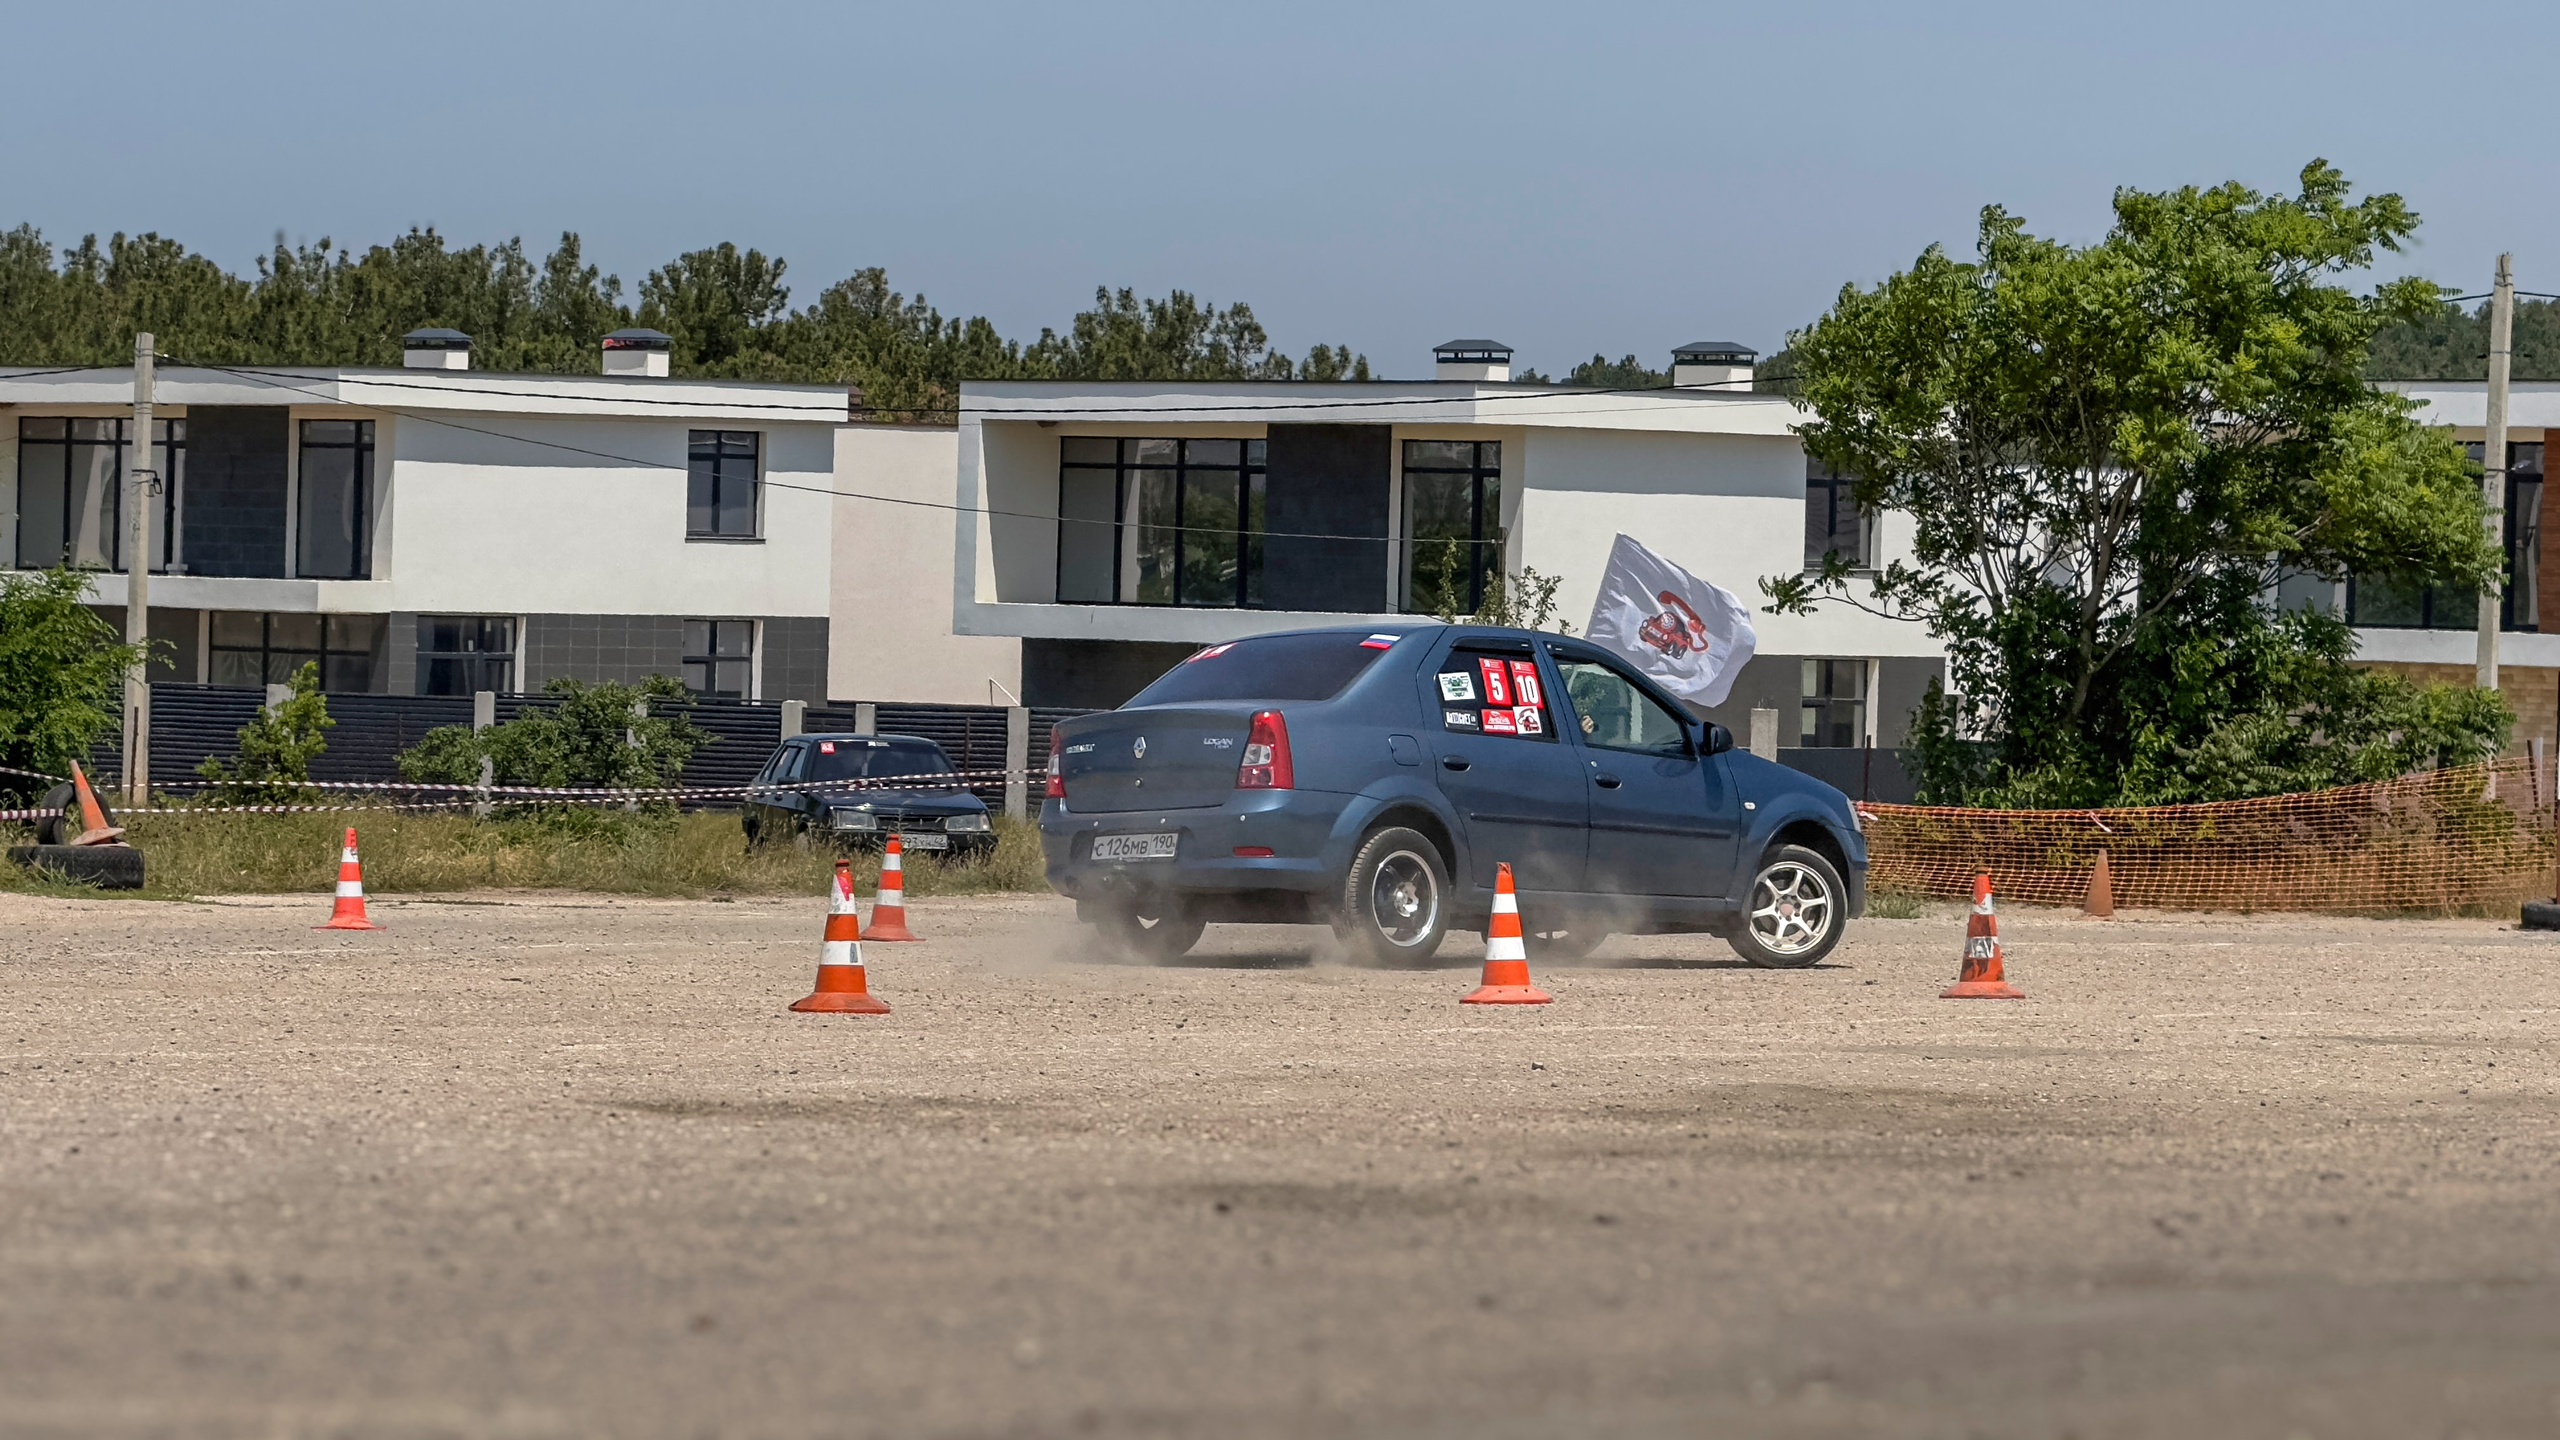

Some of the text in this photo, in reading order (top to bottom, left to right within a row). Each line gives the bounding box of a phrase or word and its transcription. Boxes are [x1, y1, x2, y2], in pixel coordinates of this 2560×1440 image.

[1489, 672, 1504, 701] 5
[1516, 675, 1539, 704] 10
[1203, 737, 1233, 746] LOGAN
[1153, 835, 1174, 849] 190
